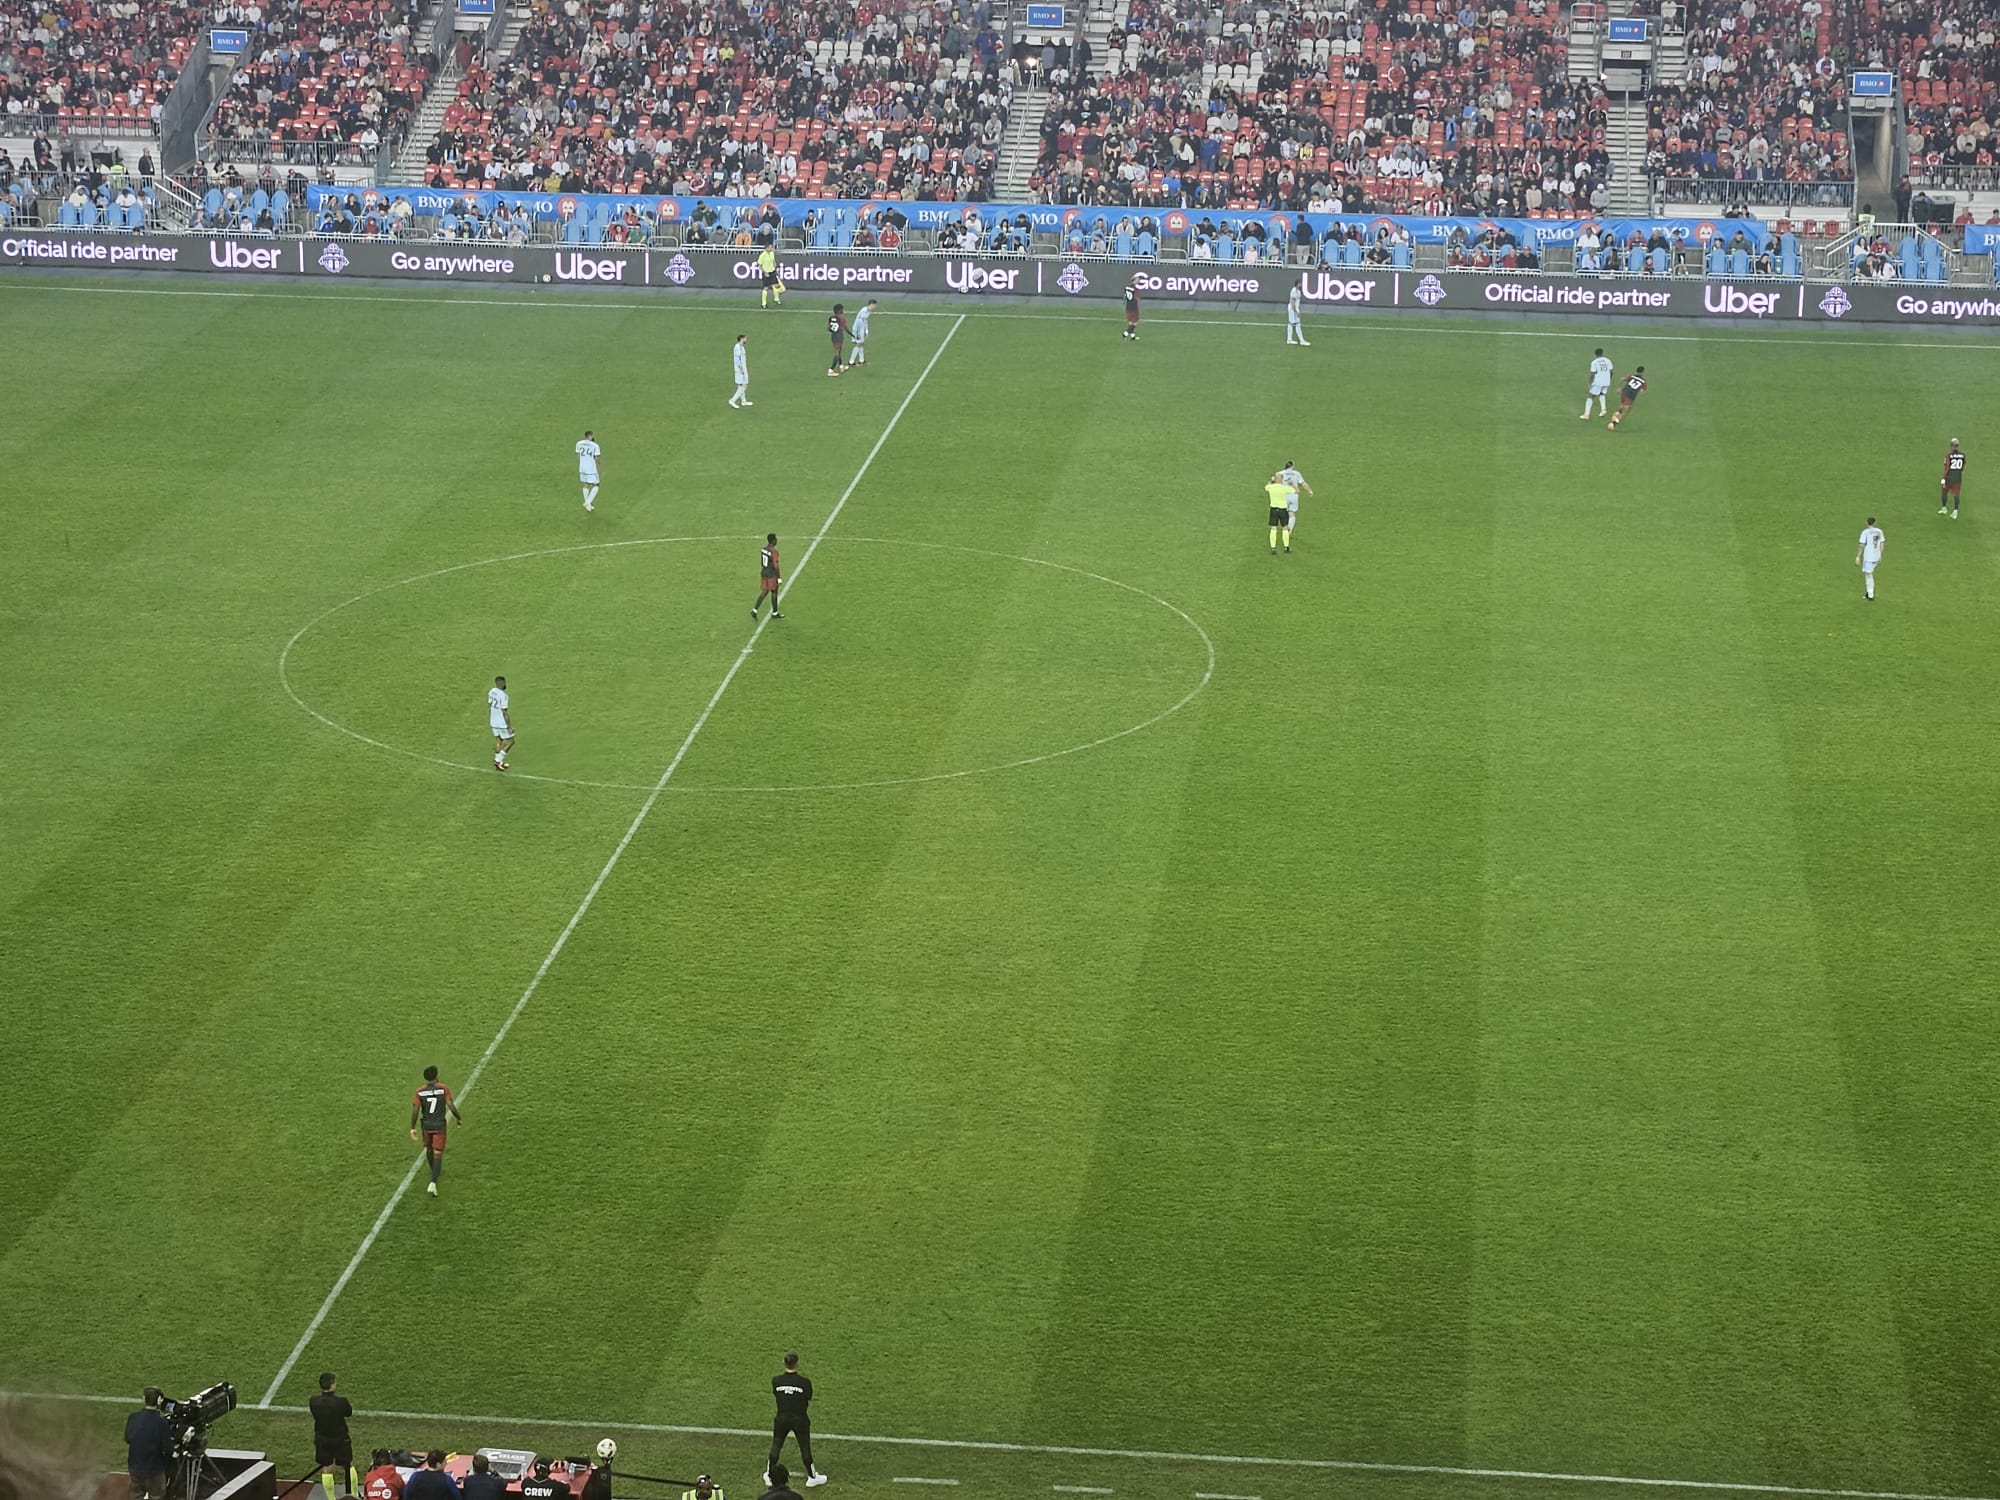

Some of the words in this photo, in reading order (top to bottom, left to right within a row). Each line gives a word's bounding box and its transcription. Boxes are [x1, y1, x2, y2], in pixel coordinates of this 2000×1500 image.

[1028, 213, 1058, 226] MO
[1536, 228, 1574, 240] BMO
[71, 241, 107, 259] ride
[110, 243, 179, 263] partner
[210, 240, 282, 269] Uber
[391, 251, 420, 270] Go
[424, 254, 515, 275] anywhere
[555, 252, 627, 281] Uber
[732, 261, 799, 280] Offial
[802, 263, 840, 281] ride
[843, 265, 913, 286] partner
[946, 261, 1019, 290] Uber
[1133, 271, 1162, 290] Go
[1166, 274, 1259, 295] anywhere
[1301, 272, 1376, 301] Uber
[1484, 282, 1553, 303] Official
[1556, 286, 1595, 304] ride
[1598, 288, 1671, 309] partner
[1704, 285, 1781, 314] Uber
[1896, 295, 1928, 315] Go
[579, 447, 593, 457] 24
[1950, 459, 1963, 470] 20
[426, 1097, 438, 1114] 7
[525, 1487, 553, 1497] CREW
